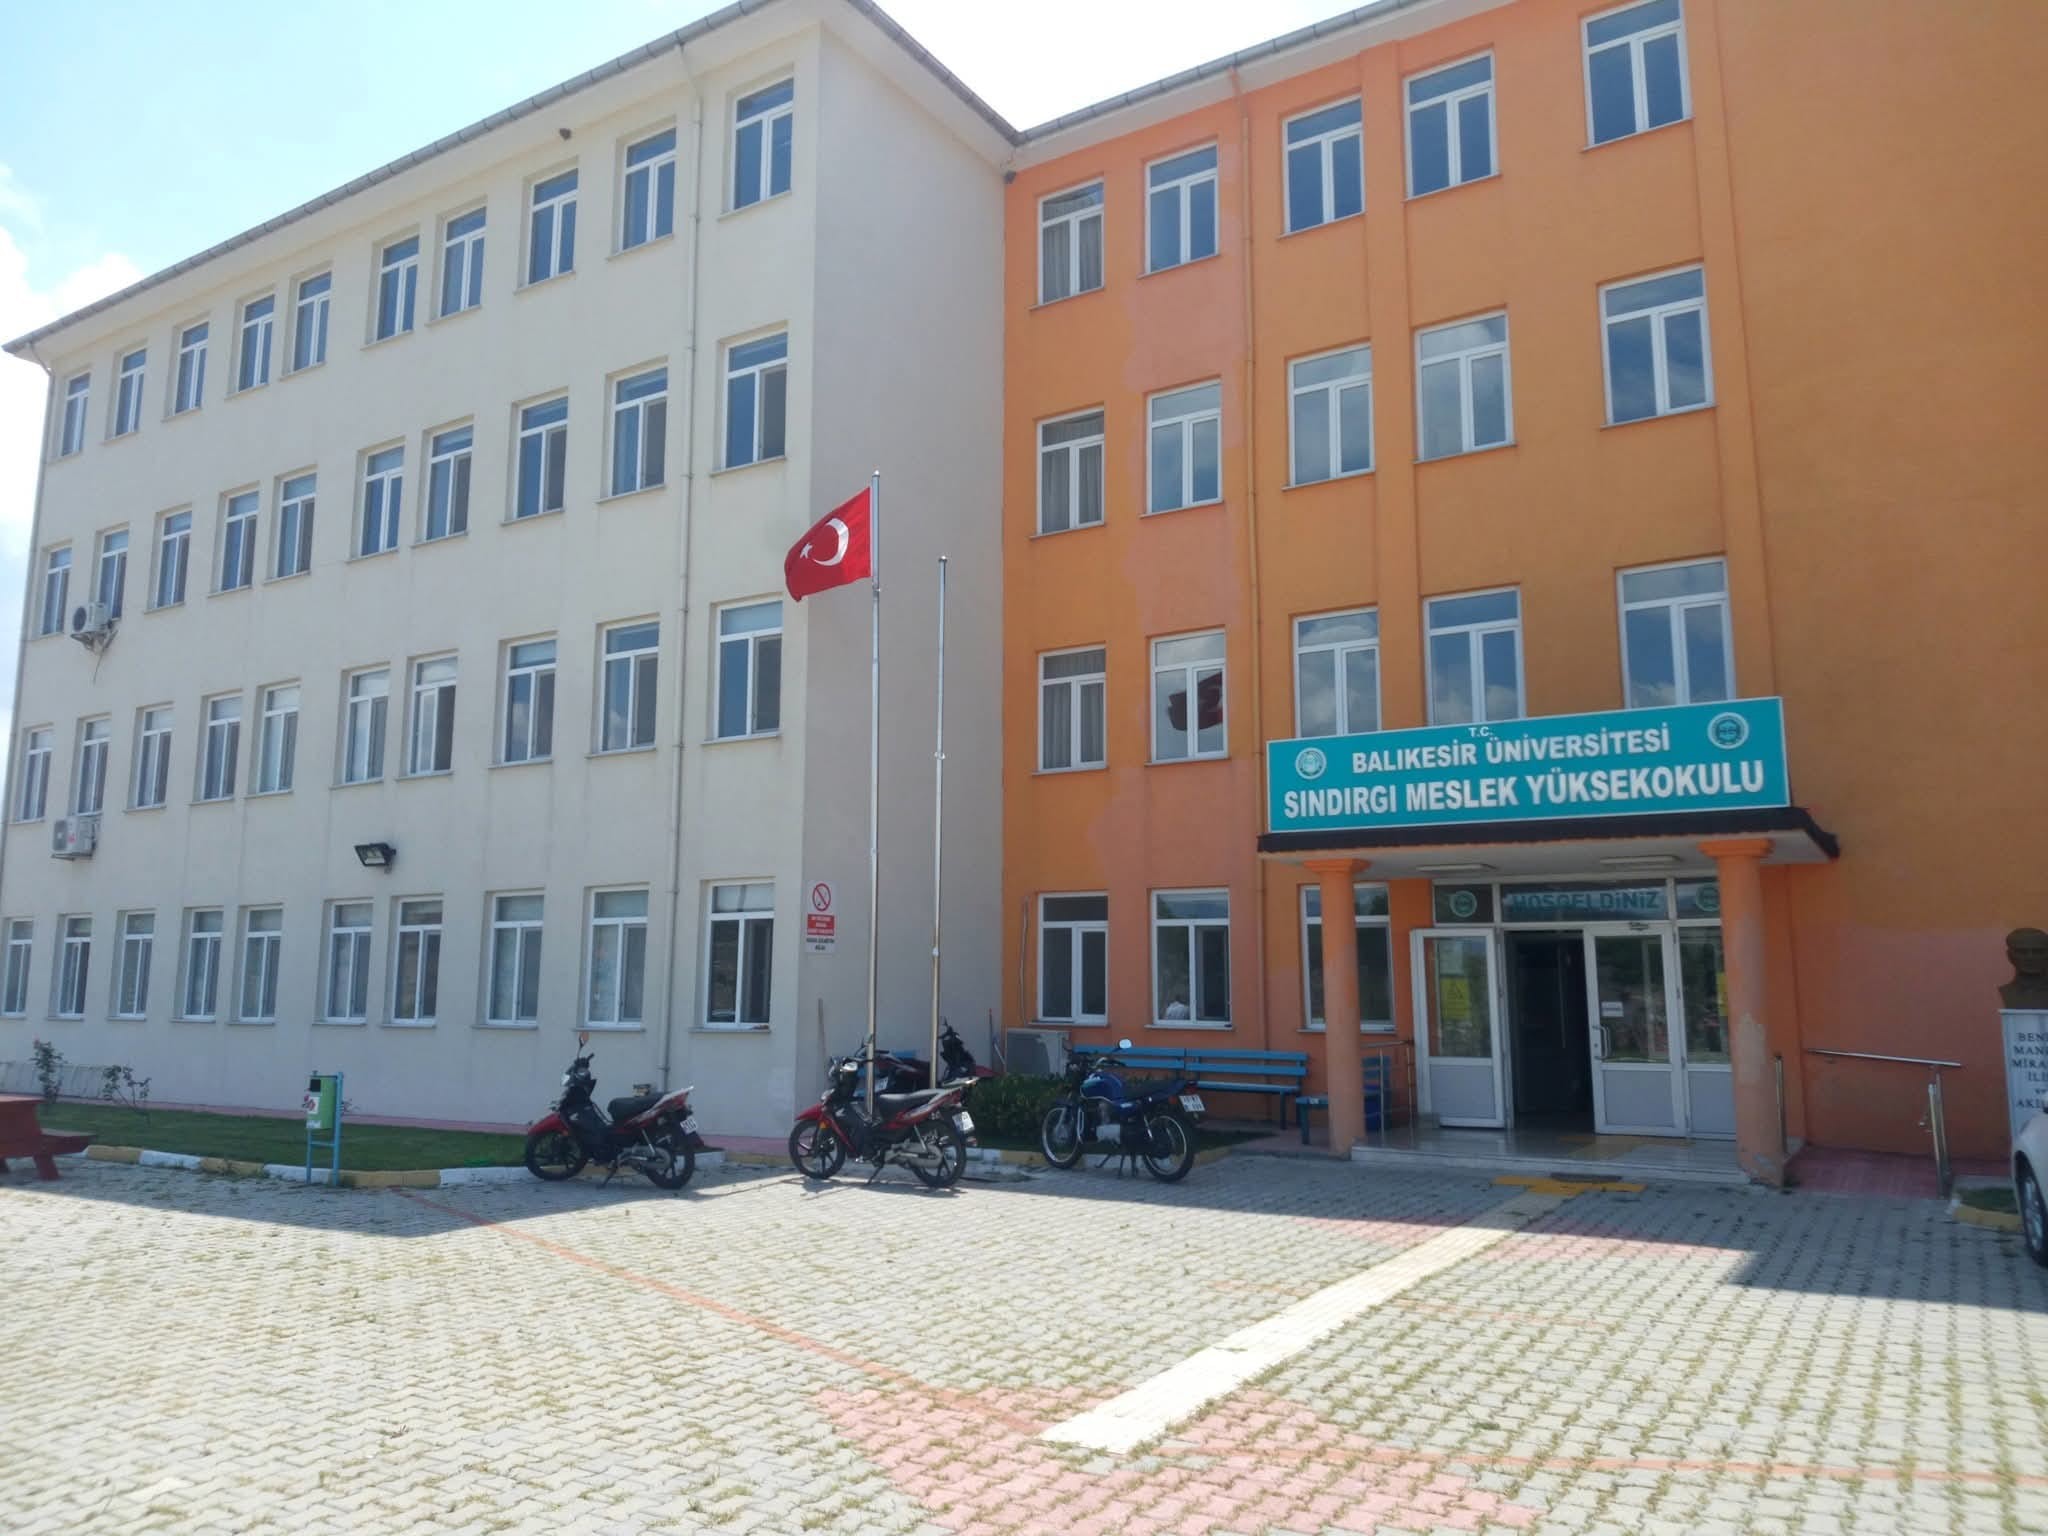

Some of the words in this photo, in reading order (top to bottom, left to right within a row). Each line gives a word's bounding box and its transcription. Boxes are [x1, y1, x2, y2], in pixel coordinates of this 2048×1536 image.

[1352, 739, 1478, 774] BALIKESİR
[1485, 721, 1671, 765] ÜNİVERSİTESİ
[1468, 726, 1494, 737] T.C.
[1284, 785, 1398, 819] SINDIRGI
[1406, 776, 1519, 812] MESLEK
[1525, 760, 1764, 805] YÜKSEKOKULU
